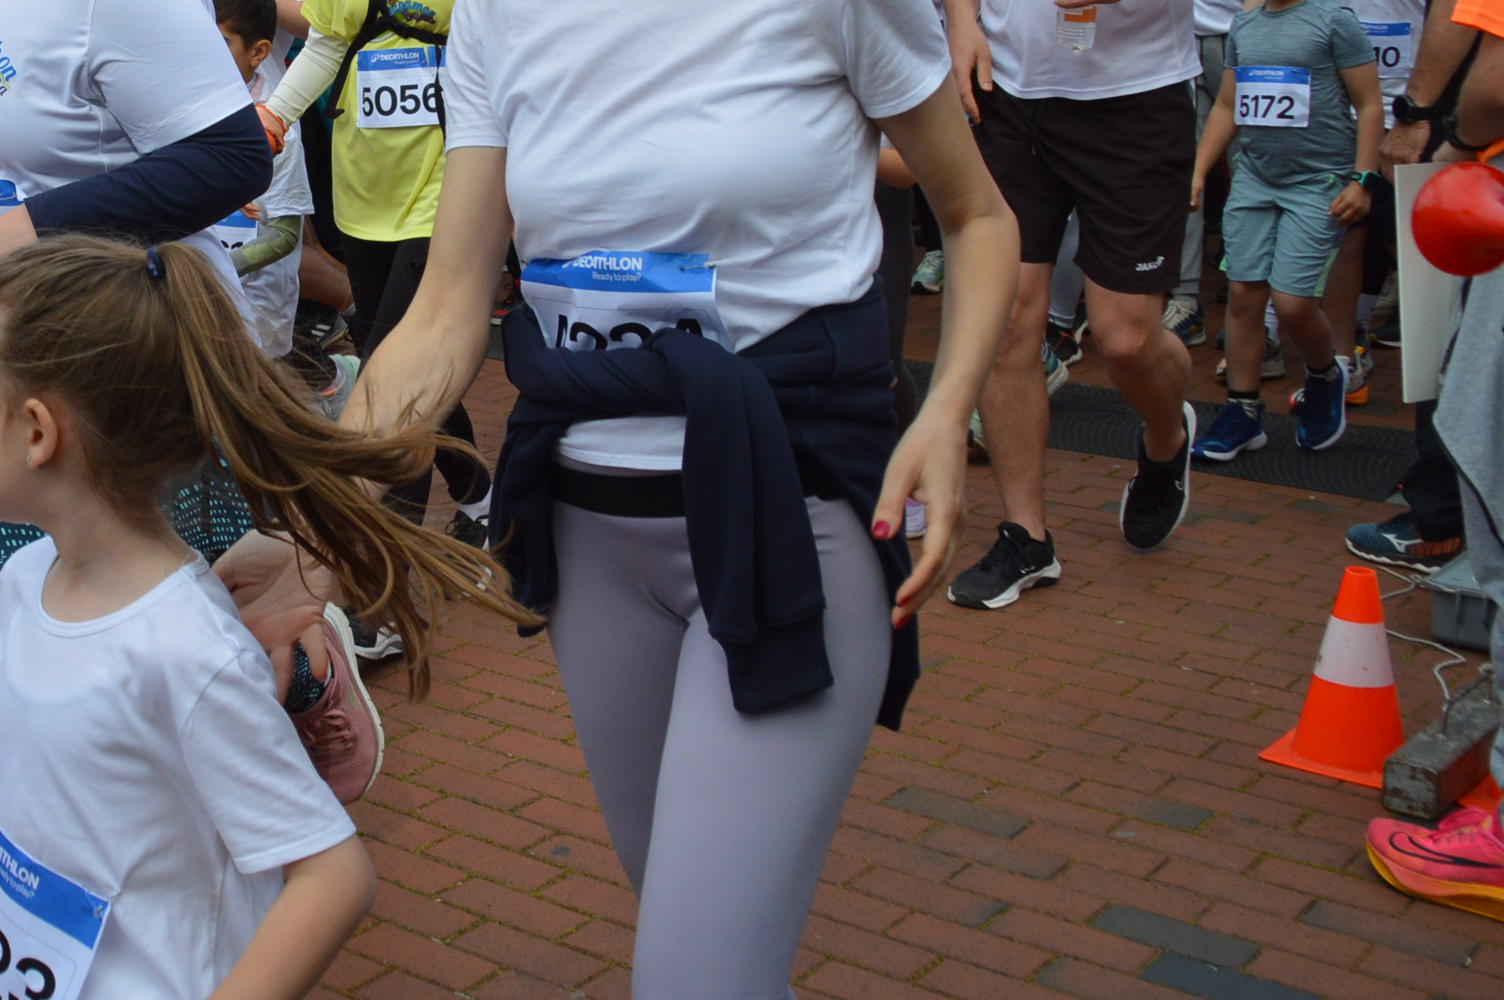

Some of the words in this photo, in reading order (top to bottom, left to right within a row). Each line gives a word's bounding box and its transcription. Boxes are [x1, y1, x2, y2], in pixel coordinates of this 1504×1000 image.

[362, 82, 441, 118] 5056
[1239, 94, 1295, 120] 5172
[573, 256, 643, 271] DECATHLON
[592, 271, 613, 282] Ready
[614, 272, 622, 281] to
[623, 272, 642, 283] play?
